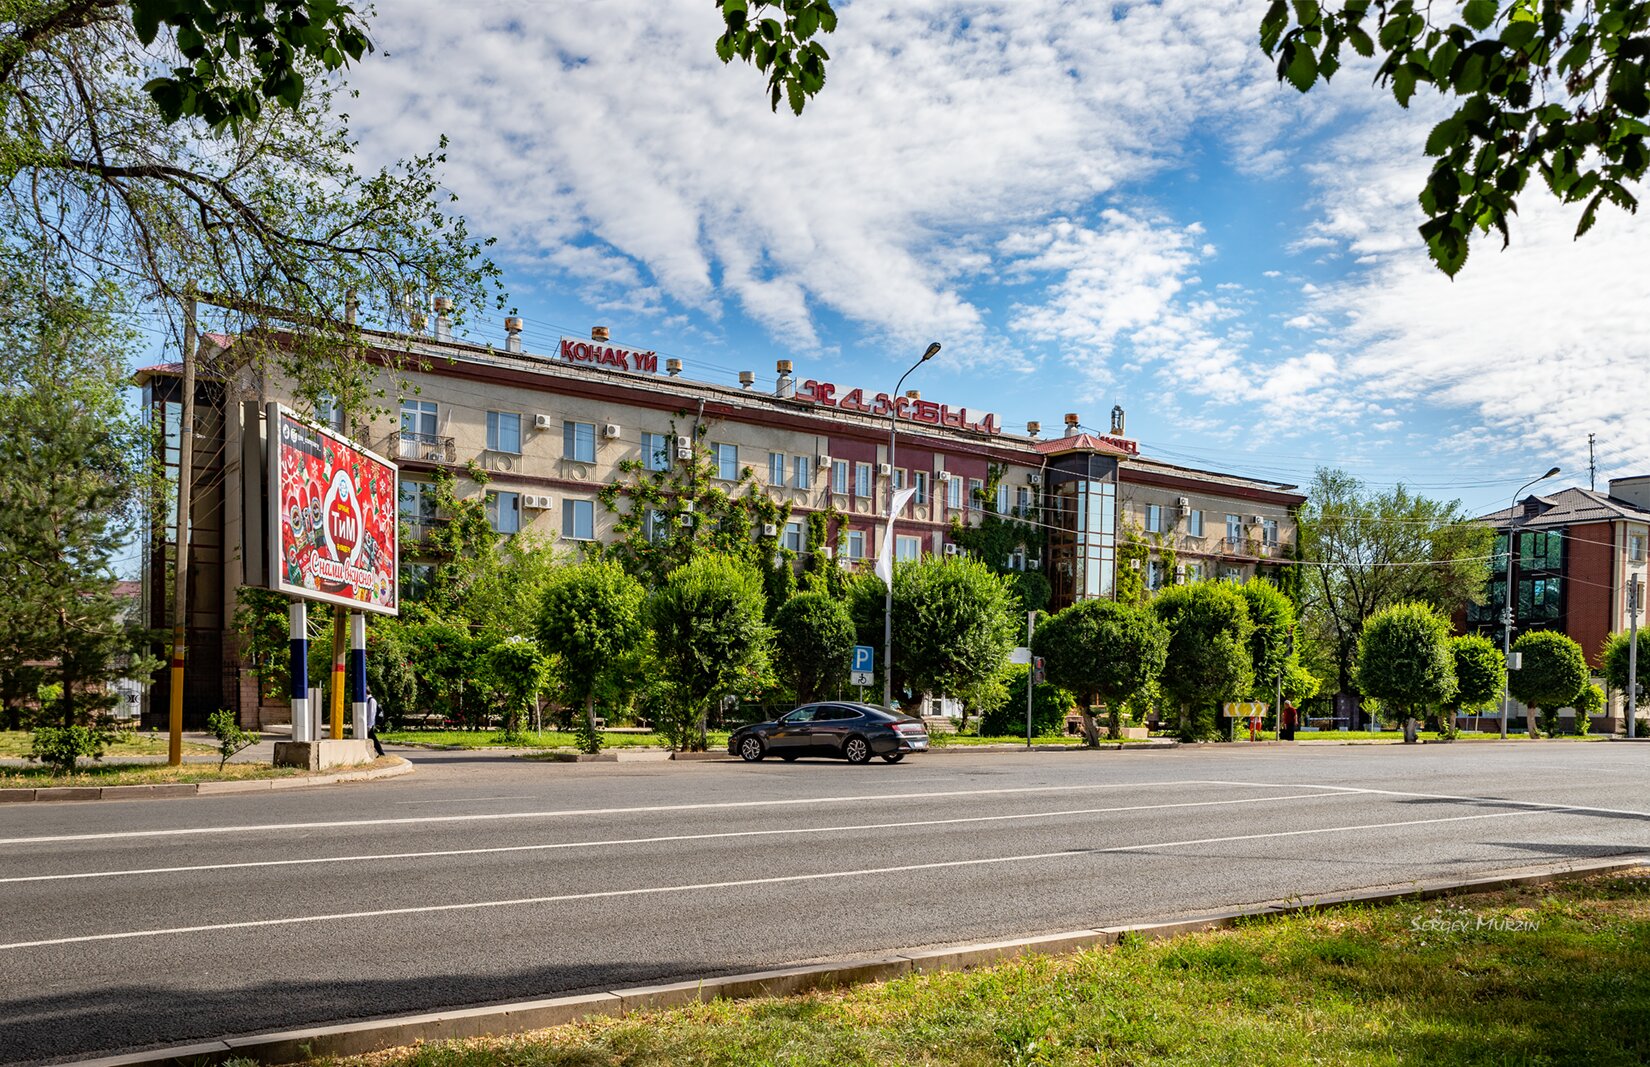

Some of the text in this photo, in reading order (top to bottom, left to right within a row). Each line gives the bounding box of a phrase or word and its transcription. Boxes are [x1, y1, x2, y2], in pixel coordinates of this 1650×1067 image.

[561, 340, 658, 373] ҚОНАҚ ҮЙ
[795, 379, 1001, 435] ЖАМБЫЛ
[856, 648, 869, 669] P
